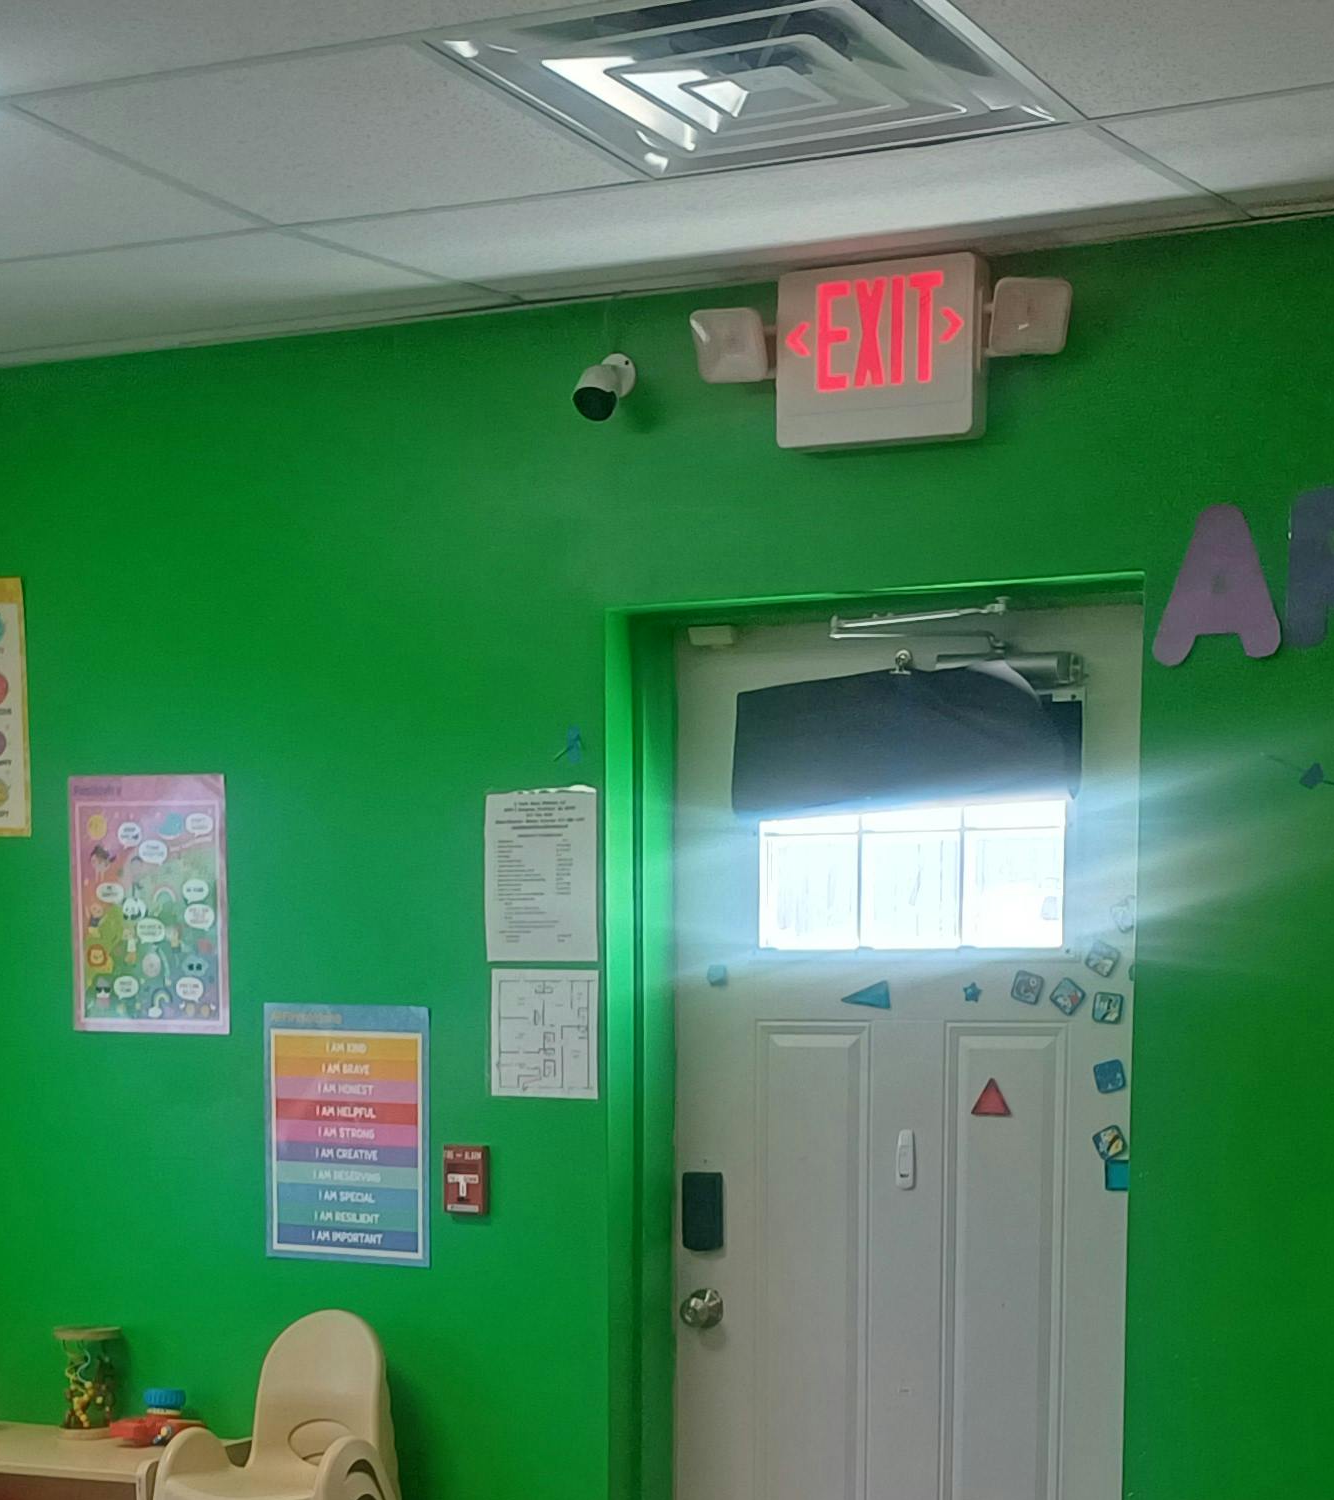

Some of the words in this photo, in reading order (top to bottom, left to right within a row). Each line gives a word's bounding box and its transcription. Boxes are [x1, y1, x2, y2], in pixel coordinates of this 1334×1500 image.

[815, 270, 944, 393] EXIT
[331, 1042, 345, 1054] AM
[327, 1063, 340, 1074] AM
[342, 1064, 370, 1076] BRAVE
[322, 1083, 336, 1094] AM
[321, 1105, 335, 1117] AM
[337, 1106, 376, 1119] HELPFUL
[323, 1126, 336, 1137] AM
[339, 1127, 375, 1139] STRONG
[320, 1148, 334, 1159] AM
[336, 1148, 378, 1161] CREATIVE
[318, 1169, 331, 1180] AM
[324, 1190, 337, 1201] AM
[339, 1190, 375, 1203] SPECIAL
[319, 1210, 332, 1221] AM
[317, 1230, 330, 1241] AM
[332, 1231, 382, 1244] IMPORTANT
